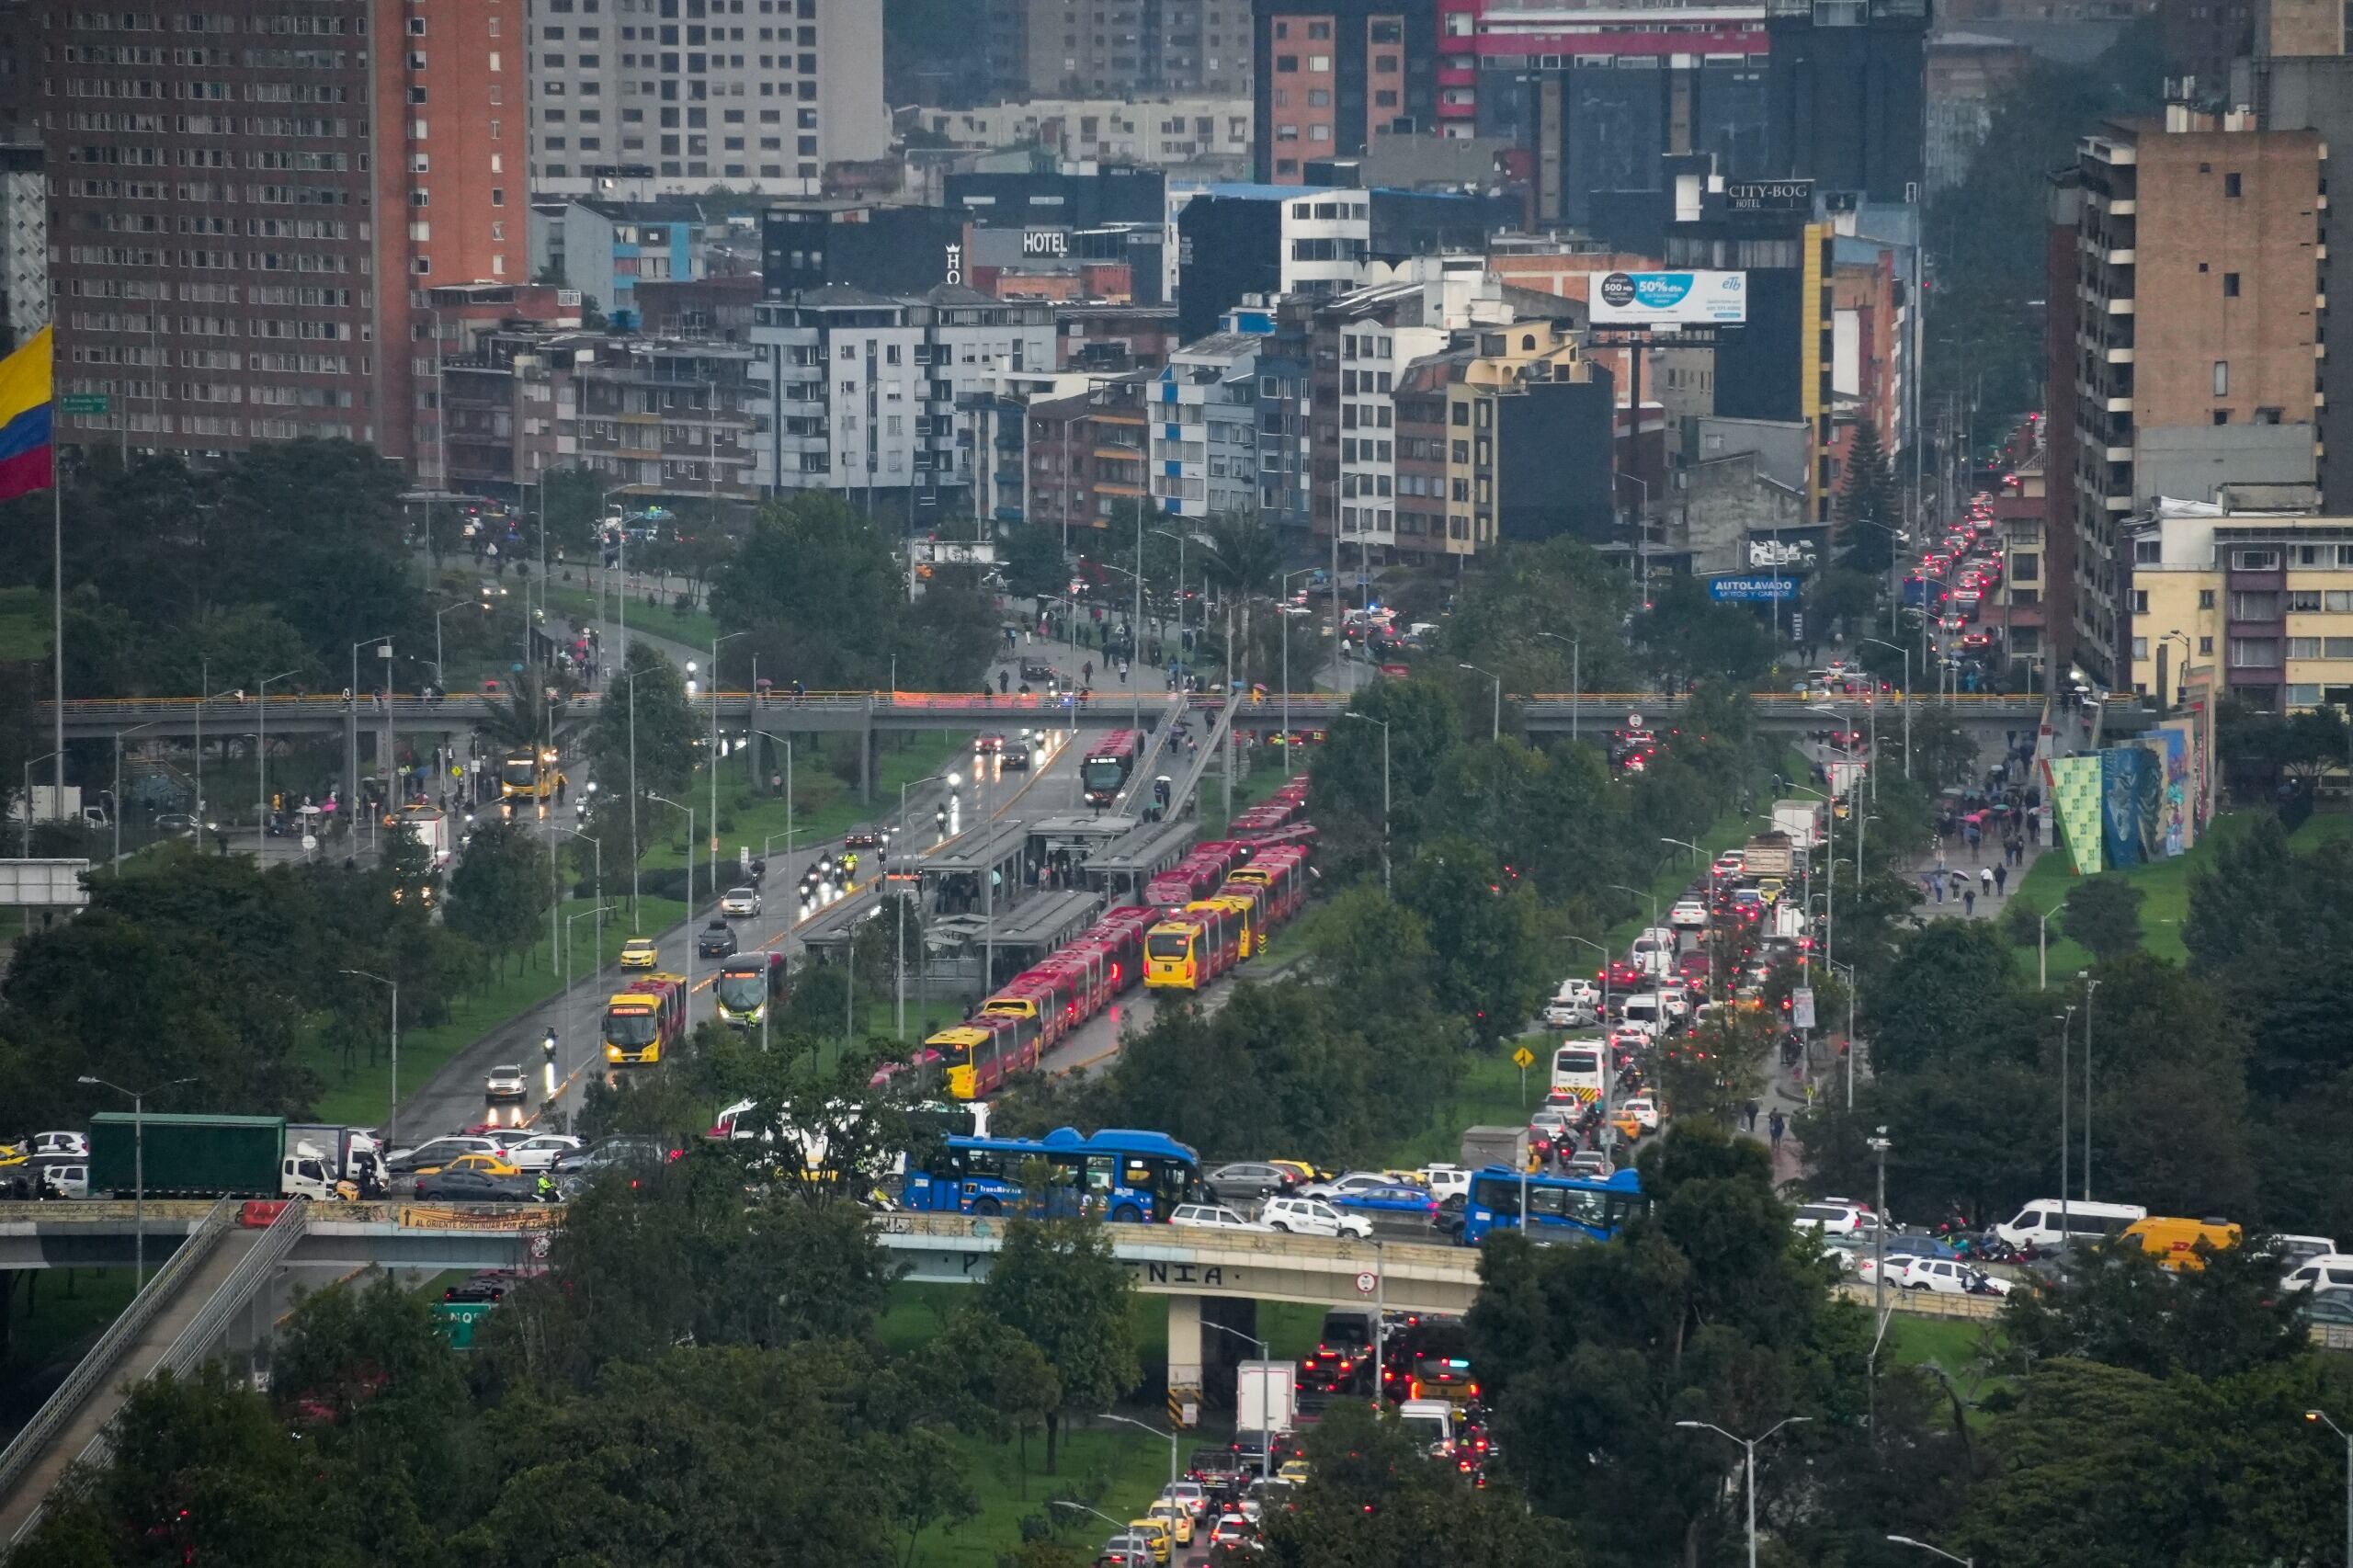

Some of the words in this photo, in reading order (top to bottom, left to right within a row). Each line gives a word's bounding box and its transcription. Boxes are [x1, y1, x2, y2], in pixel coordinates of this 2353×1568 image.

[1729, 185, 1807, 198] CITY-BOG
[1023, 233, 1068, 253] HOTEL
[1604, 283, 1622, 291] 500
[1715, 581, 1792, 590] AUTOLAVADO
[415, 1219, 424, 1227] AL
[426, 1220, 457, 1228] ORIENTE
[460, 1221, 500, 1229] CONTINUAR
